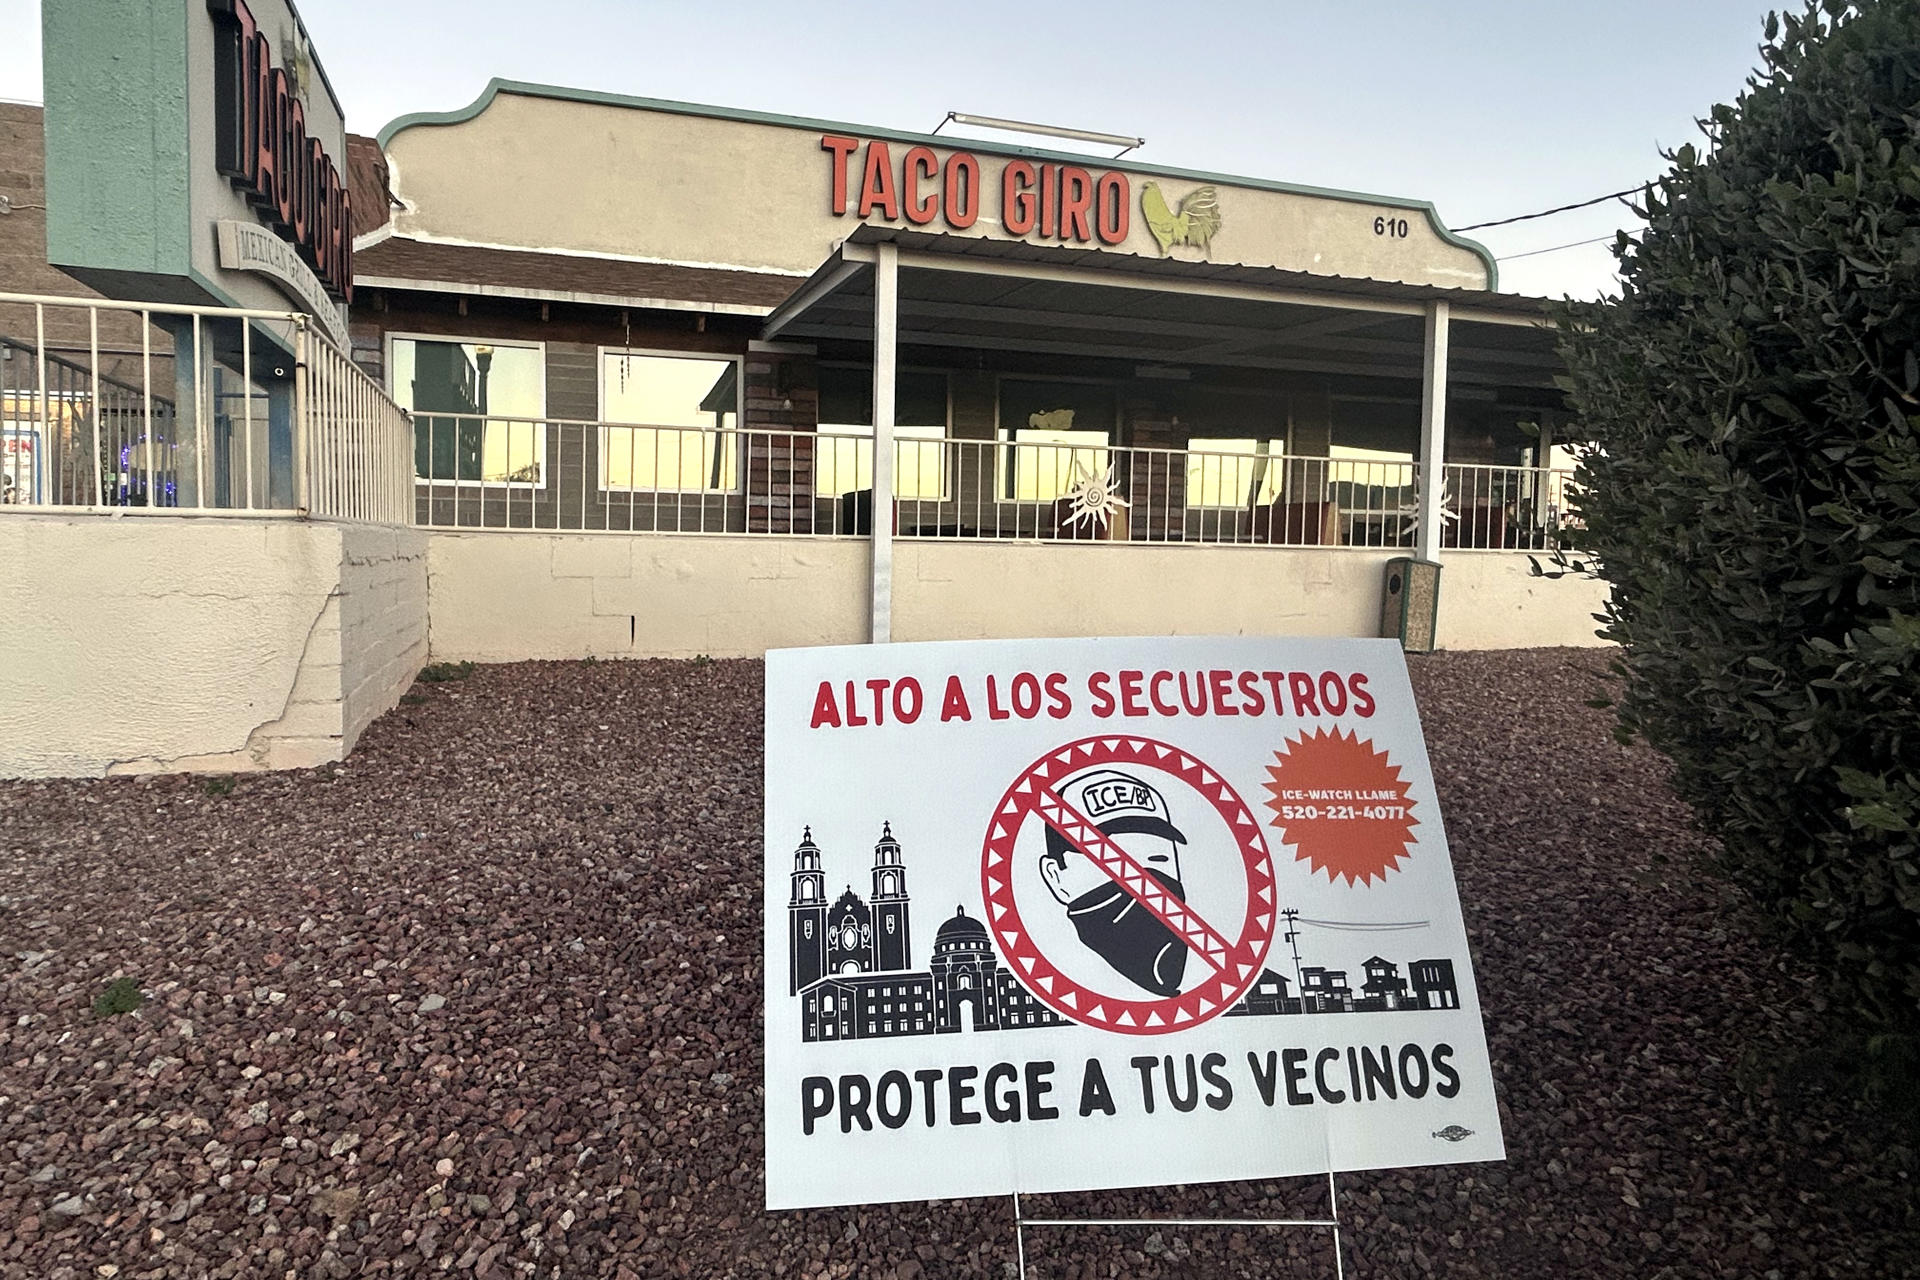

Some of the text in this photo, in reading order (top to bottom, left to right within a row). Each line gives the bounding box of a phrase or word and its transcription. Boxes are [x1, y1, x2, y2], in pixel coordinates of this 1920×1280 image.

[822, 134, 1131, 247] TACO GIRO
[1374, 216, 1408, 238] 610
[240, 230, 287, 272] MEXICAN
[811, 670, 1376, 729] ALTO A LOS SECUESTROS
[1281, 789, 1398, 801] ICE-WATCH LLAME
[1281, 805, 1405, 820] 520-221-4077
[801, 1043, 1461, 1136] PROTEGE A TUS VECINOS
